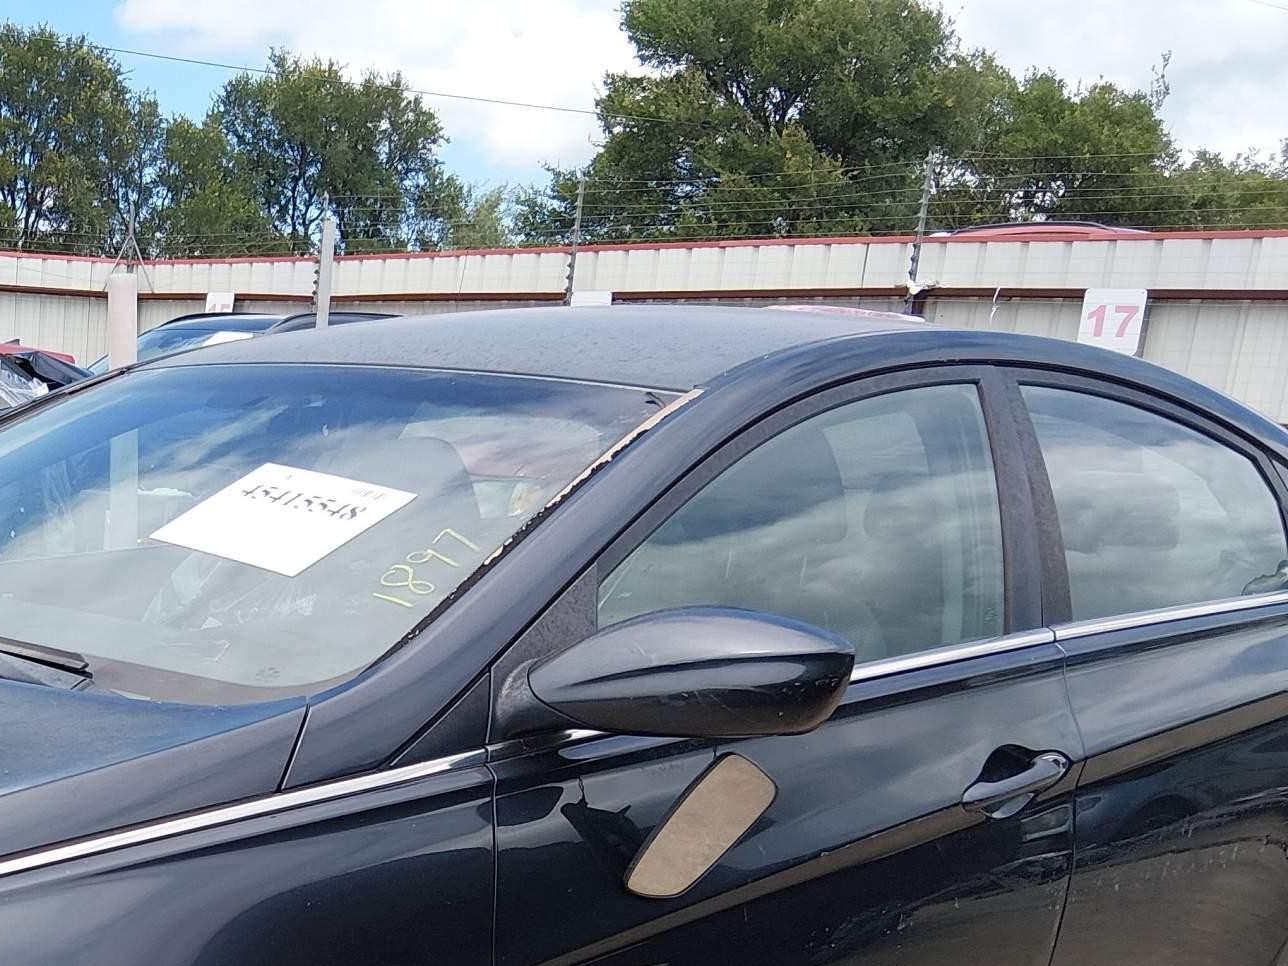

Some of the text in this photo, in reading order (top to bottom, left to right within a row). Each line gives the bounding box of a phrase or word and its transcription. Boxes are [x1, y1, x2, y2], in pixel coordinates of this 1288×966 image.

[1087, 304, 1140, 338] 17
[241, 484, 367, 520] 45415548
[373, 528, 481, 608] 1897
